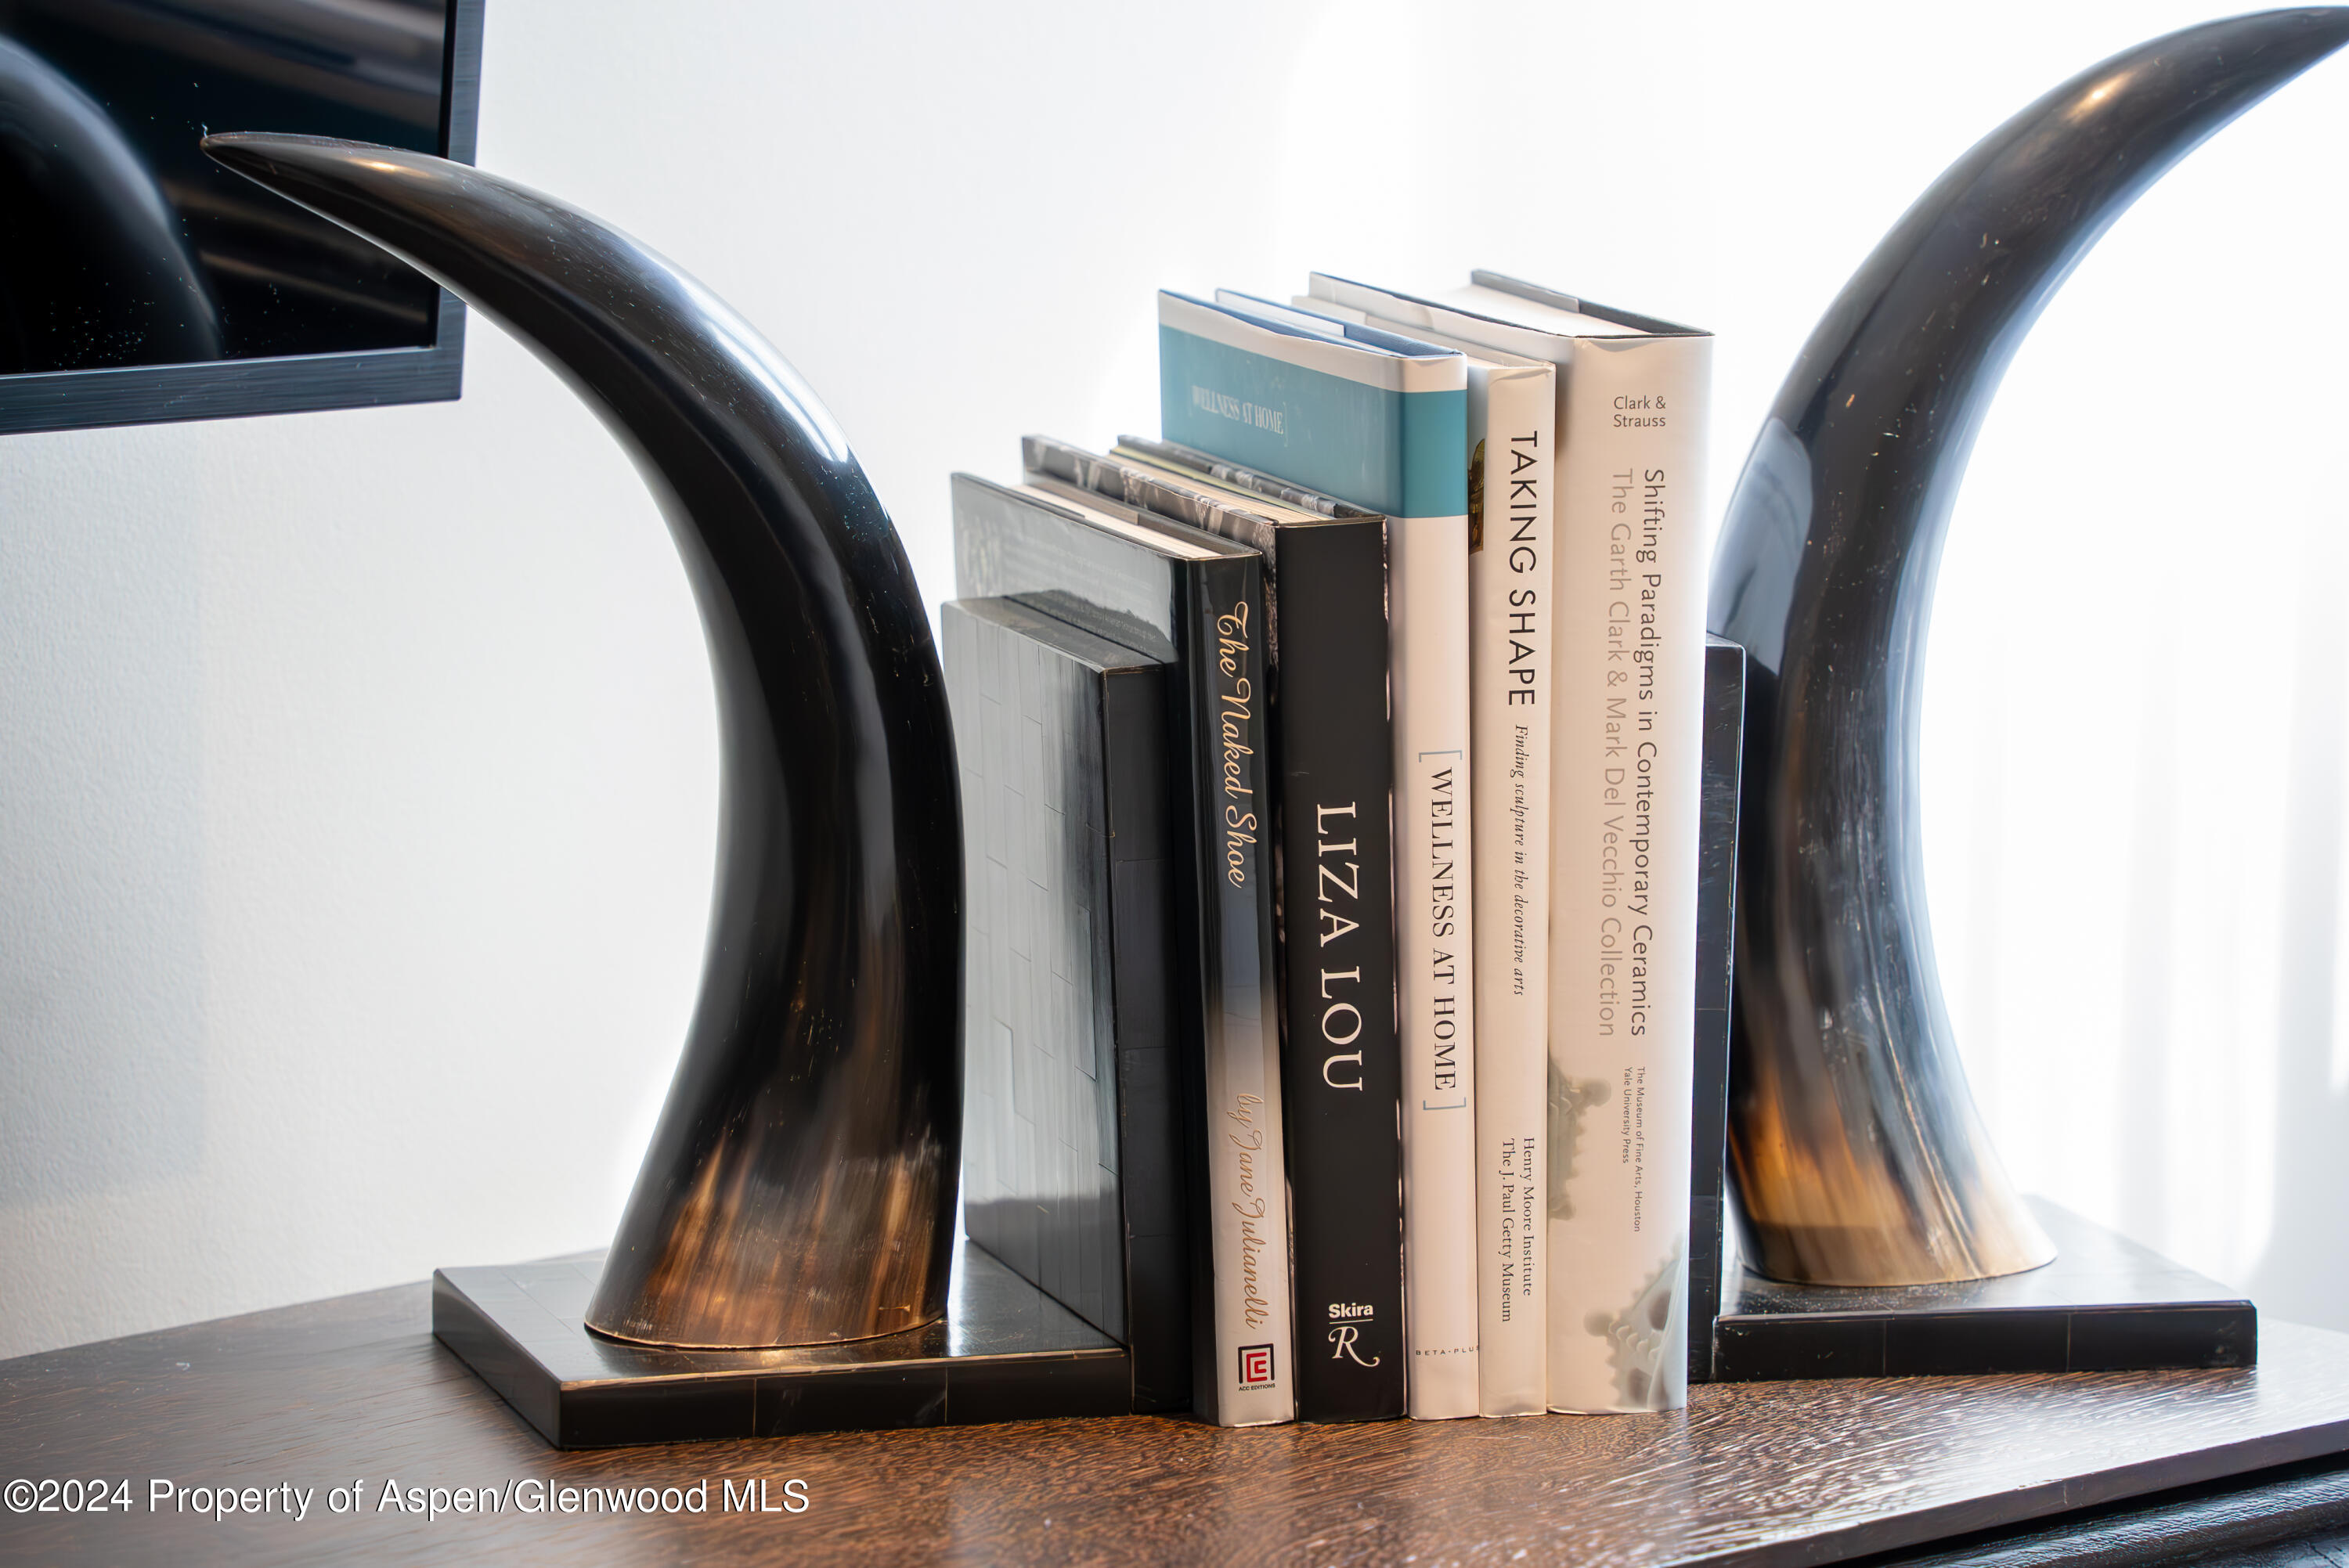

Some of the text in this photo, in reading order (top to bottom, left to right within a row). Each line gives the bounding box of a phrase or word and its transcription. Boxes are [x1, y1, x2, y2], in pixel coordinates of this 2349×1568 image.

[1254, 405, 1284, 434] HOME
[1614, 414, 1665, 427] Strauss
[1615, 395, 1665, 409] Clark &
[1509, 431, 1537, 705] TAKING SHAPE
[1218, 602, 1257, 888] The Naked Shoe
[1600, 468, 1634, 1035] The Garth Clark & Mark Del Vecchio Collection
[1628, 470, 1665, 1036] Shifting Paradigms in Contemporary Ceramics
[1317, 802, 1362, 1090] LIZA LOU
[1431, 767, 1455, 1090] WELLNESS AT HOME
[1510, 724, 1530, 996] Finding sculpture in the decorative arts
[1621, 1067, 1633, 1164] Yale University Press
[1633, 1066, 1646, 1232] The Museum of Fine Arts, Houston
[1227, 1093, 1269, 1330] by Jane Julianelli
[1498, 1137, 1516, 1322] The J. Paul Getty Museum
[1519, 1137, 1535, 1296] Henry Moore Institute
[1250, 1382, 1276, 1391] EDITIONS
[1329, 1303, 1373, 1319] Skira
